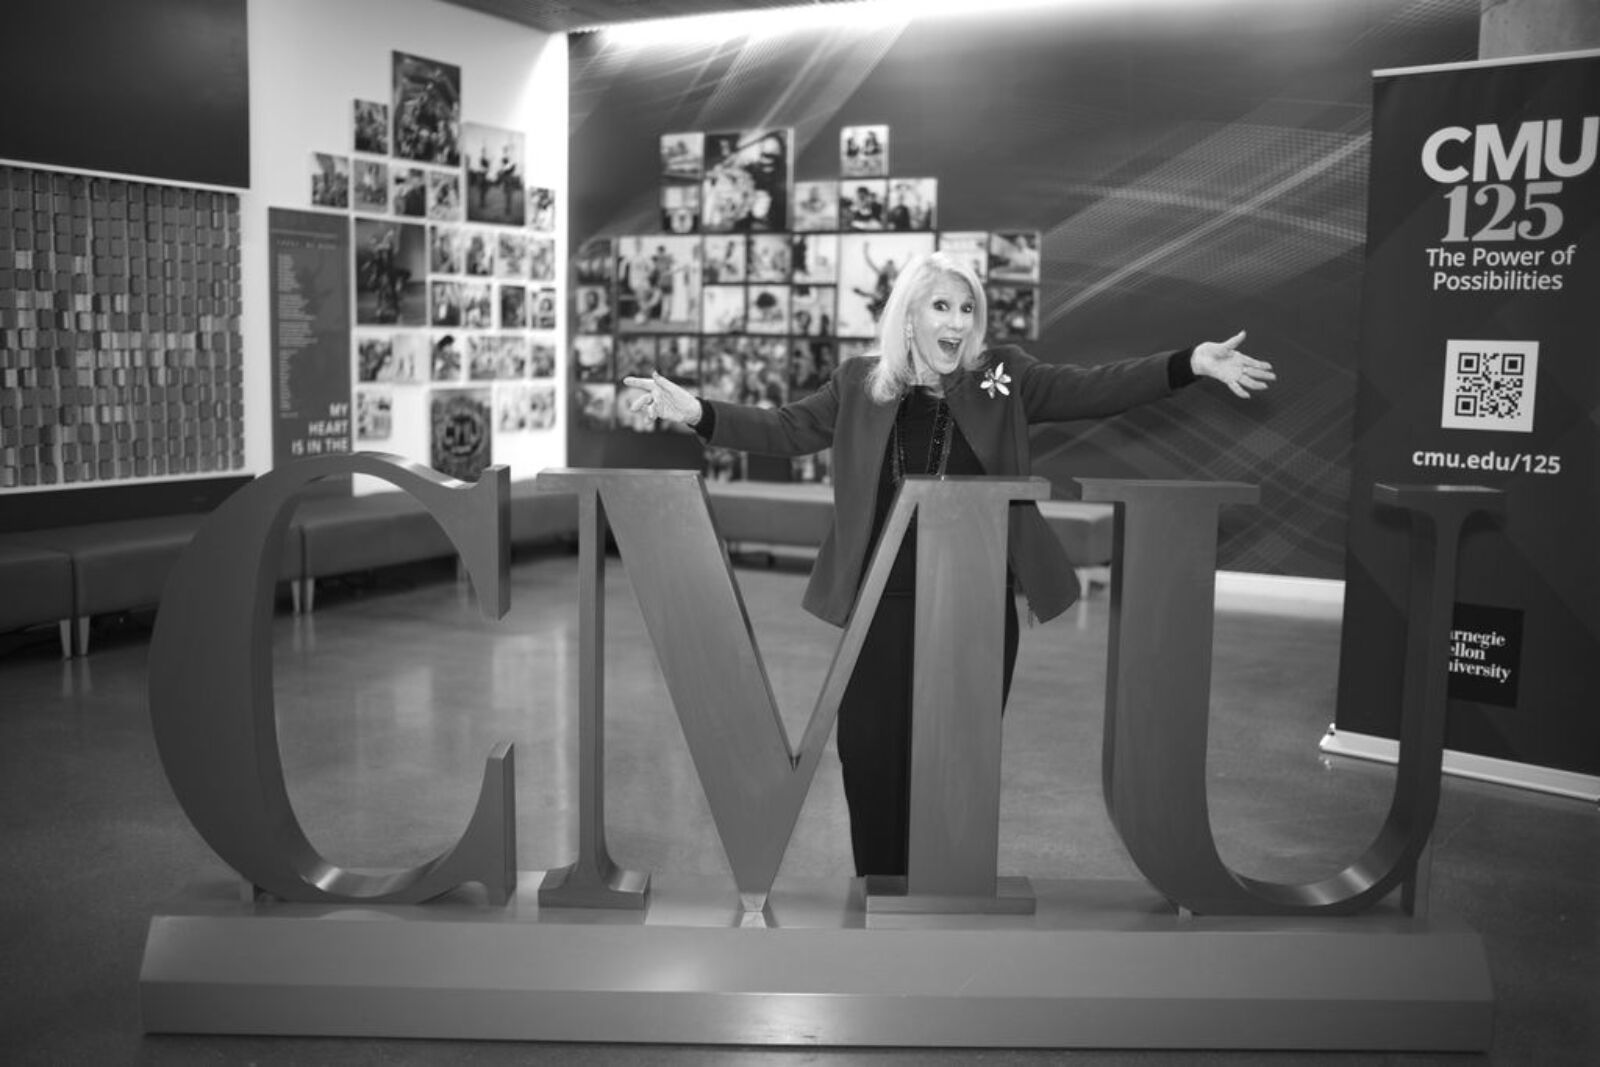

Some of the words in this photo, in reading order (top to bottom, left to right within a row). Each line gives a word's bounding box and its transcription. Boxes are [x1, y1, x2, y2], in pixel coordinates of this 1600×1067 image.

[1421, 117, 1600, 183] CMU
[1440, 181, 1564, 242] 125
[1425, 247, 1465, 267] The
[1472, 247, 1545, 267] Power
[1551, 244, 1577, 265] of
[1433, 270, 1564, 291] Possibilities
[330, 403, 348, 417] MY
[308, 420, 348, 436] HEART
[291, 439, 304, 455] IS
[307, 439, 322, 454] IN
[325, 437, 348, 452] THE
[1412, 450, 1561, 475] cmu.edu/125
[1448, 659, 1511, 683] iversity
[149, 452, 1505, 918] CMU
